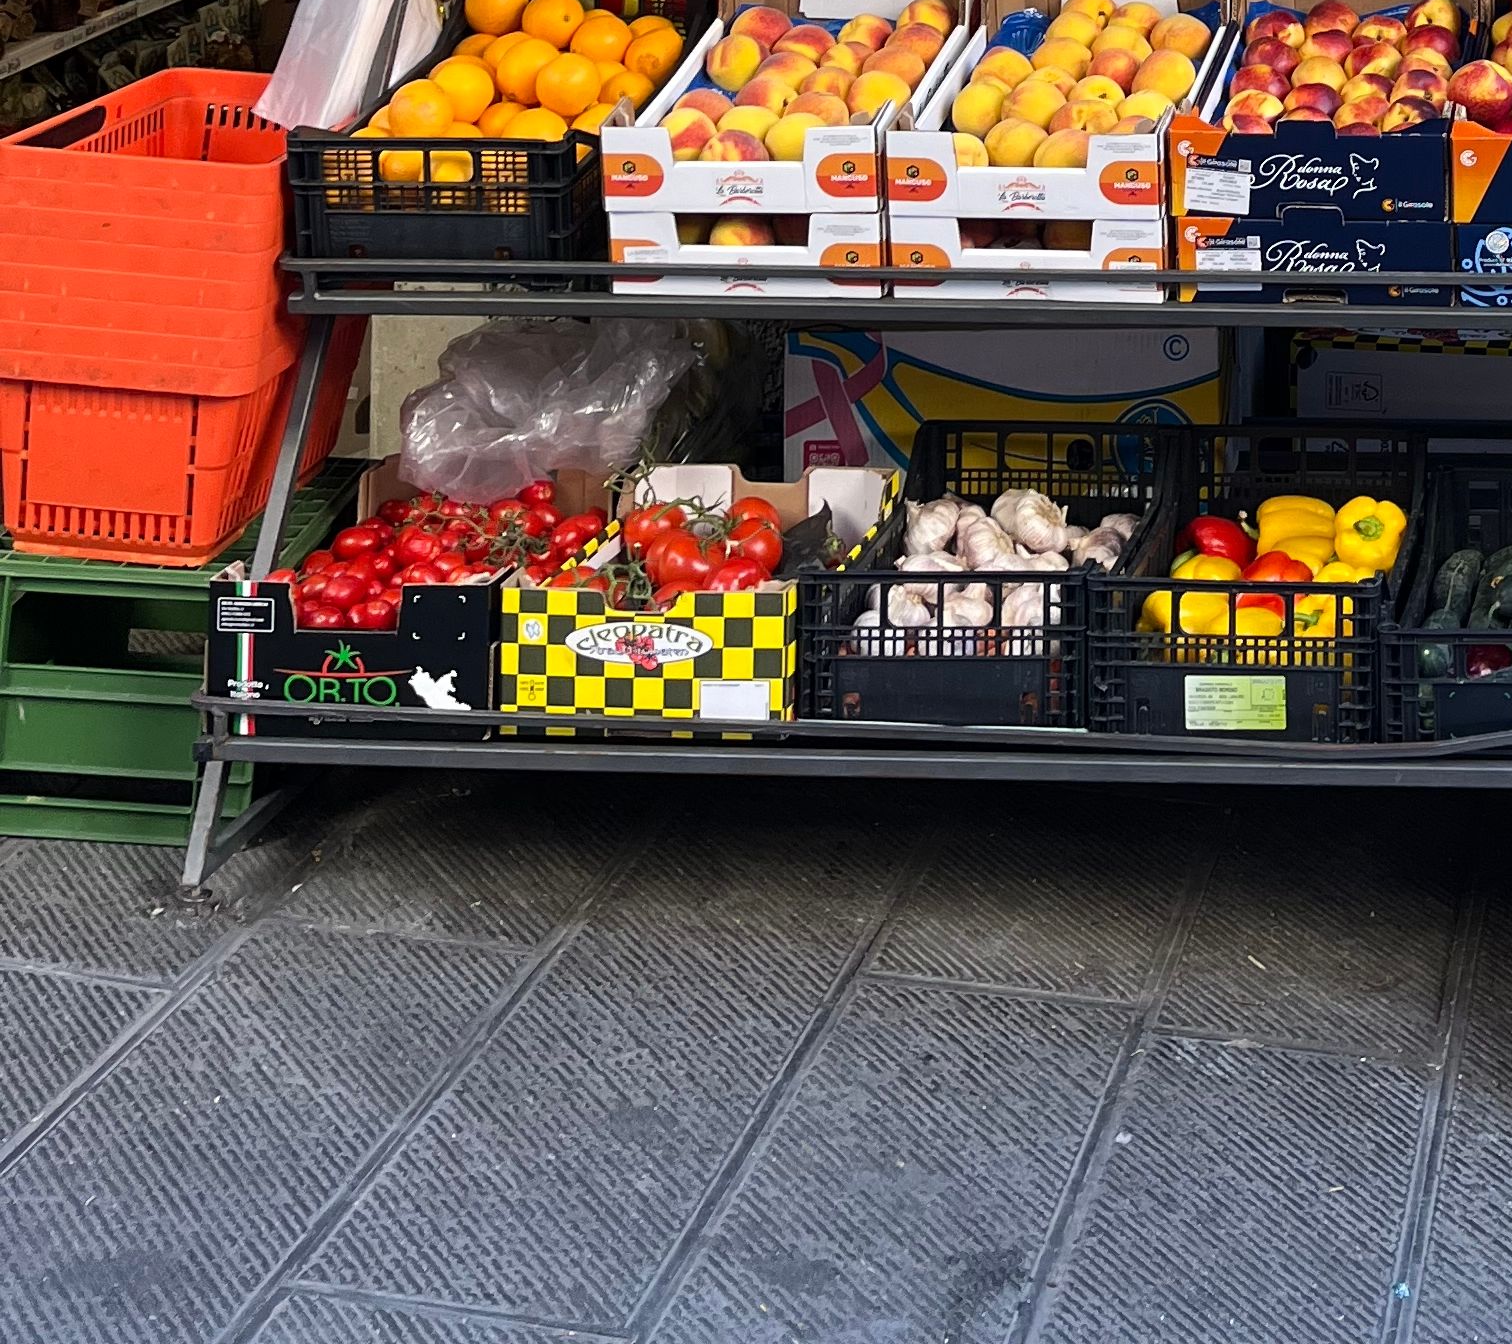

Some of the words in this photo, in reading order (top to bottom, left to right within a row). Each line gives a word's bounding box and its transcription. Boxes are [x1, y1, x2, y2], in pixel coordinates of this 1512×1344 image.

[1249, 153, 1349, 196] Rosa
[1297, 157, 1342, 175] donna
[1303, 242, 1349, 260] donna
[576, 622, 704, 653] cleopatra
